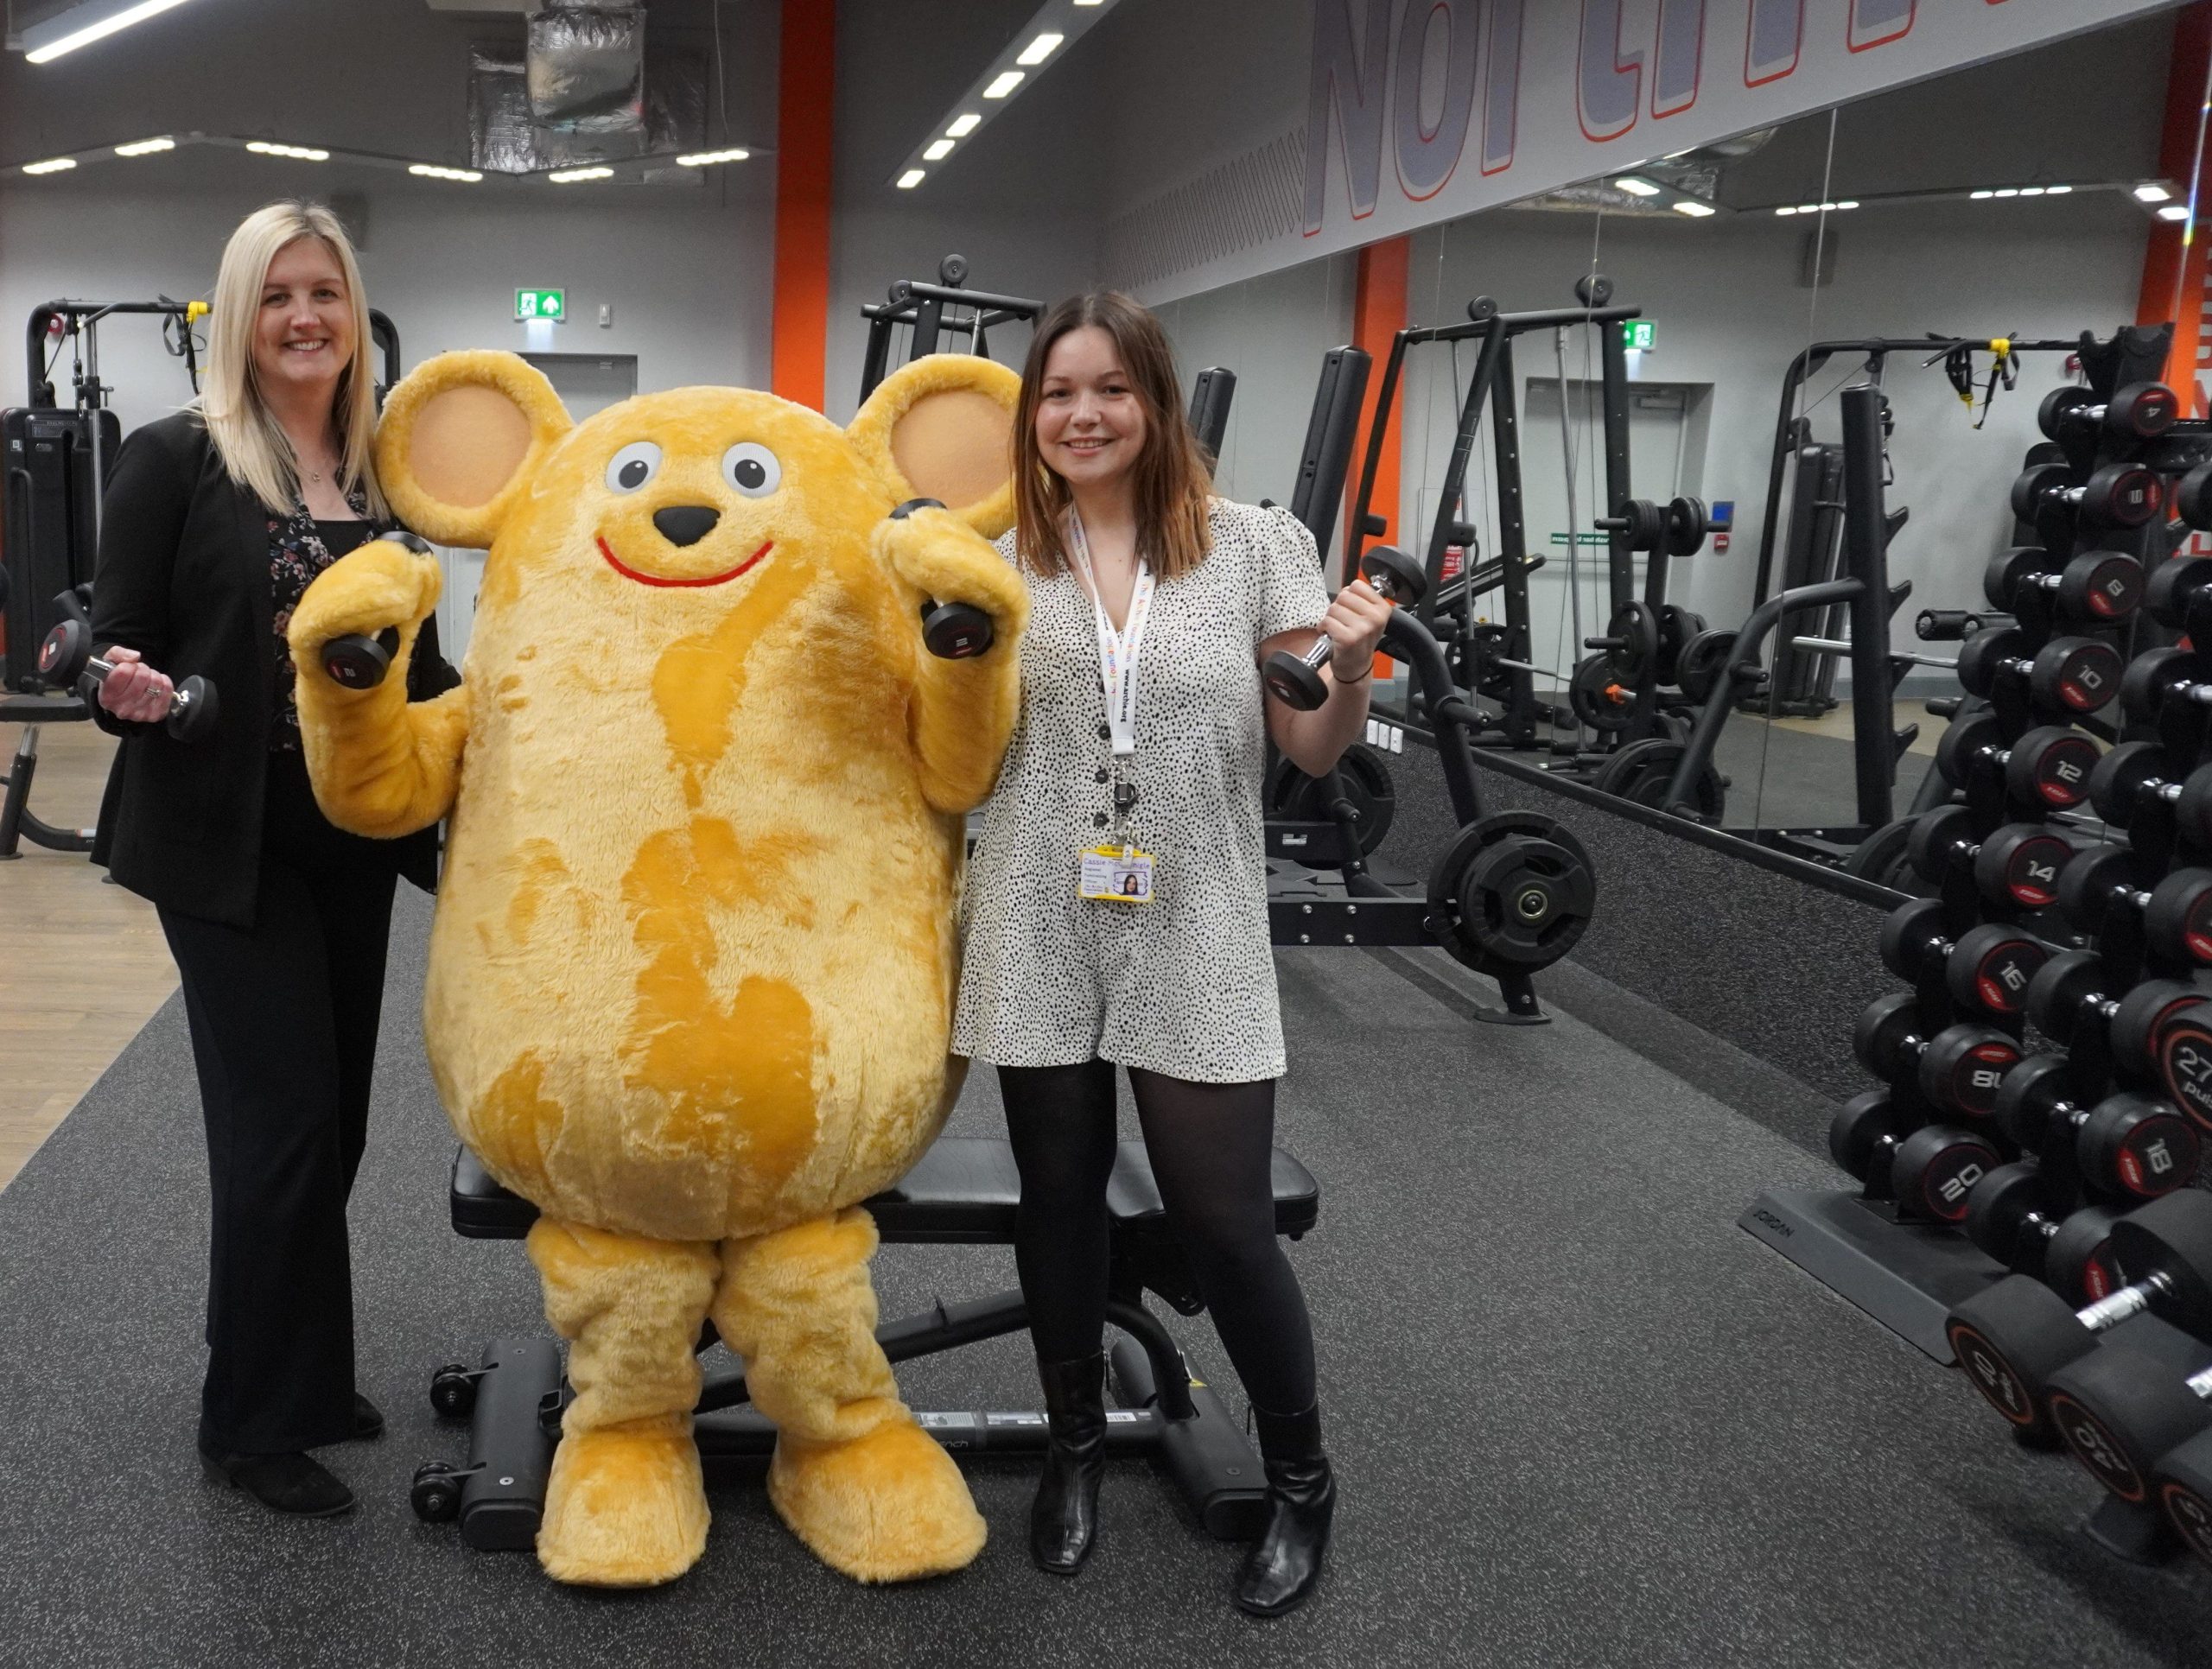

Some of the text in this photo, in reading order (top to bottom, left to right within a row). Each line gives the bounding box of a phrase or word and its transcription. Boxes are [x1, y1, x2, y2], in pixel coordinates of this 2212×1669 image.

[2078, 663, 2103, 689] 10
[2056, 760, 2083, 784] 12
[2027, 860, 2056, 883] 14
[2000, 961, 2028, 992] 16
[2145, 1138, 2173, 1174] 18
[1939, 1164, 1984, 1203] 20
